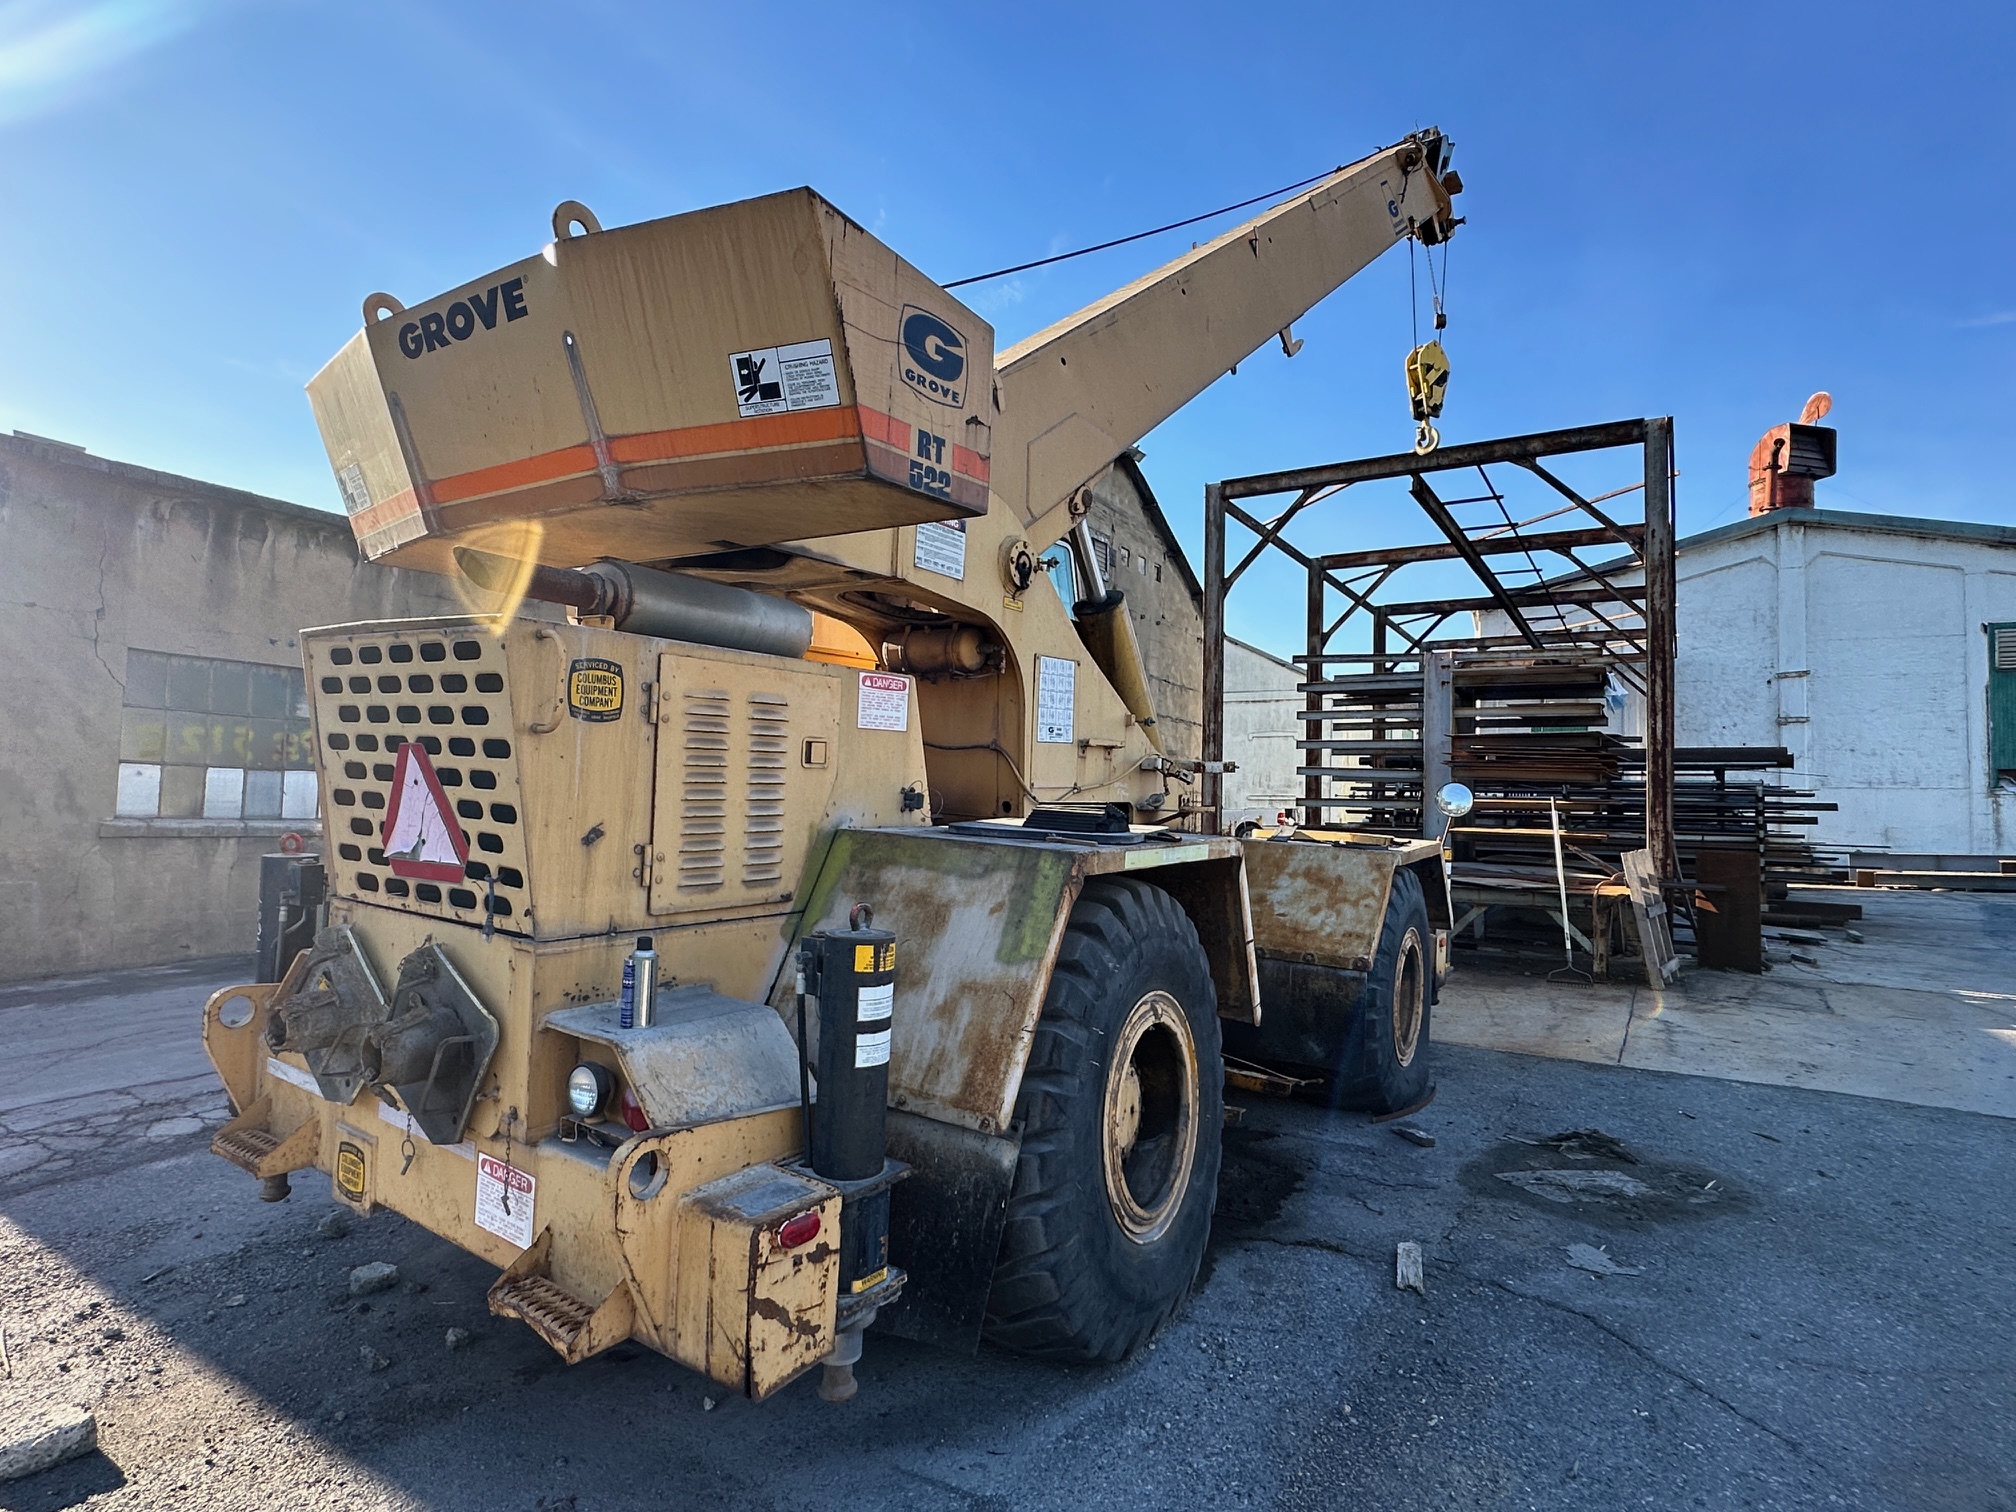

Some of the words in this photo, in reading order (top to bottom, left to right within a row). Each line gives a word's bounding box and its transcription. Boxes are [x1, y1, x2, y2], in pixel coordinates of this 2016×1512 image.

[1388, 200, 1399, 217] G
[399, 276, 529, 359] GROVE
[903, 313, 964, 382] G
[905, 368, 960, 404] GROVE
[917, 428, 946, 465] RT
[908, 458, 951, 499] 522
[575, 661, 608, 670] SERVICED
[610, 665, 620, 673] BY
[577, 673, 617, 686] COLUMBUS
[872, 677, 904, 690] DANGER
[576, 684, 618, 697] EQUIPMENT
[579, 697, 614, 707] COMPANY
